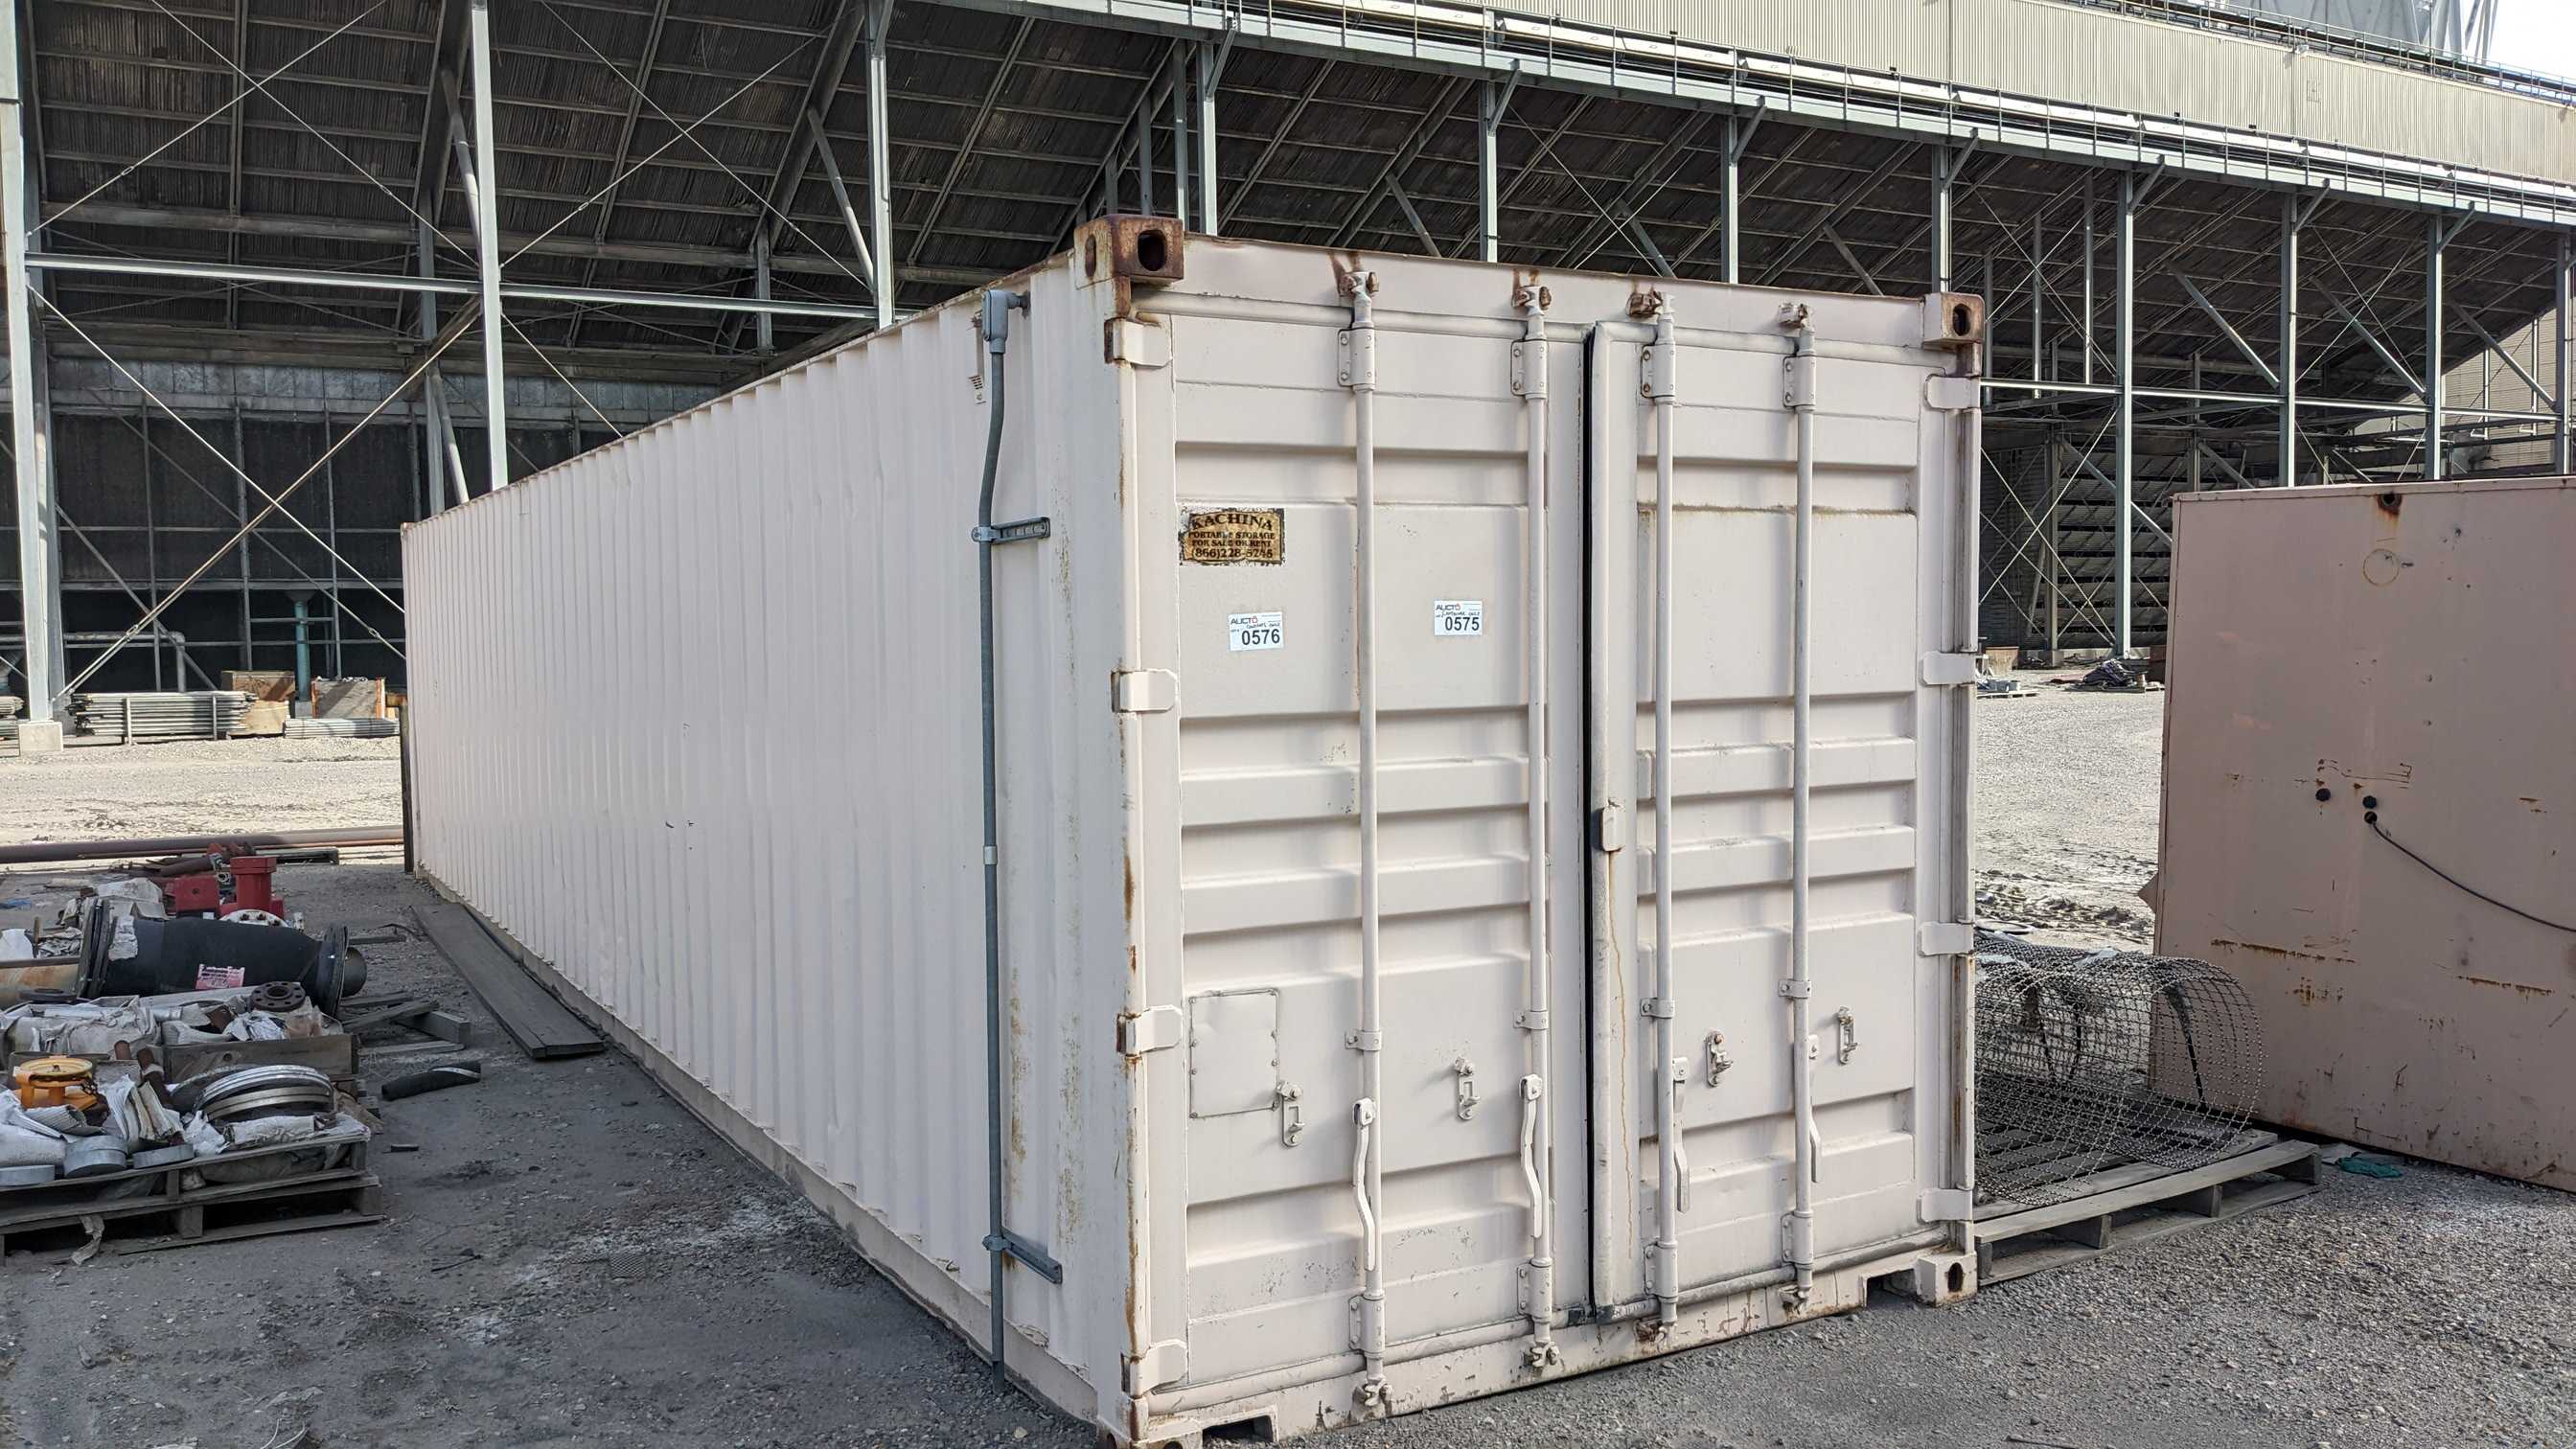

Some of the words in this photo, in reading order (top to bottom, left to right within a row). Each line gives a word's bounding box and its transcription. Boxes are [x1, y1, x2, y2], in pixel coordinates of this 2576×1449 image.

[1192, 513, 1273, 530] KACHINA
[1192, 539, 1209, 547] FOR
[1211, 539, 1233, 547] SALE
[1235, 539, 1248, 547] OR
[1250, 539, 1272, 547] RENT
[1235, 531, 1275, 540] STORAGE
[1445, 616, 1480, 631] 0575
[1242, 629, 1280, 645] 0576
